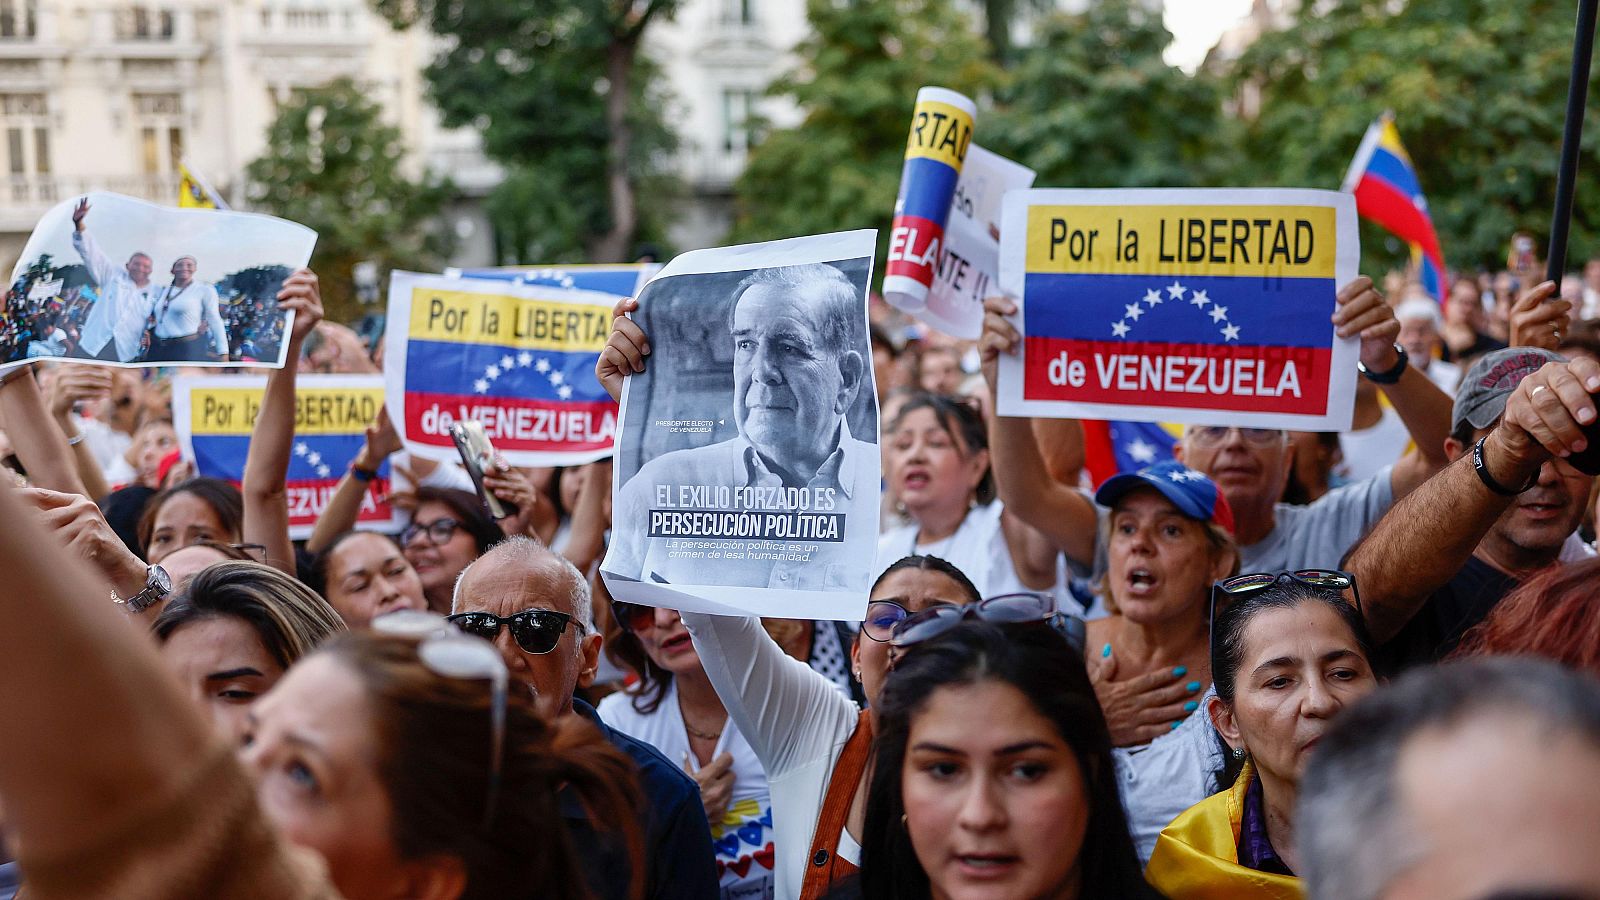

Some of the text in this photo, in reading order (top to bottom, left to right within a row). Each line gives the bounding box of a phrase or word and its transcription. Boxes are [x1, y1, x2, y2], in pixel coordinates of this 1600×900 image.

[1050, 218, 1314, 265] Por la LIBERTAD
[428, 299, 607, 342] Por la LIBERTA
[1048, 351, 1302, 398] de VENEZUELA
[203, 395, 234, 426] Por
[294, 395, 376, 426] BERTAD
[421, 403, 452, 436] de
[656, 484, 836, 511] EL EXILIO FORZADO ES
[651, 510, 838, 538] PERSECUCIÓN POLÍTICA
[665, 540, 819, 552] La persecución política es un
[707, 550, 721, 559] de
[723, 551, 745, 559] lesa
[747, 551, 812, 562] humanidad.
